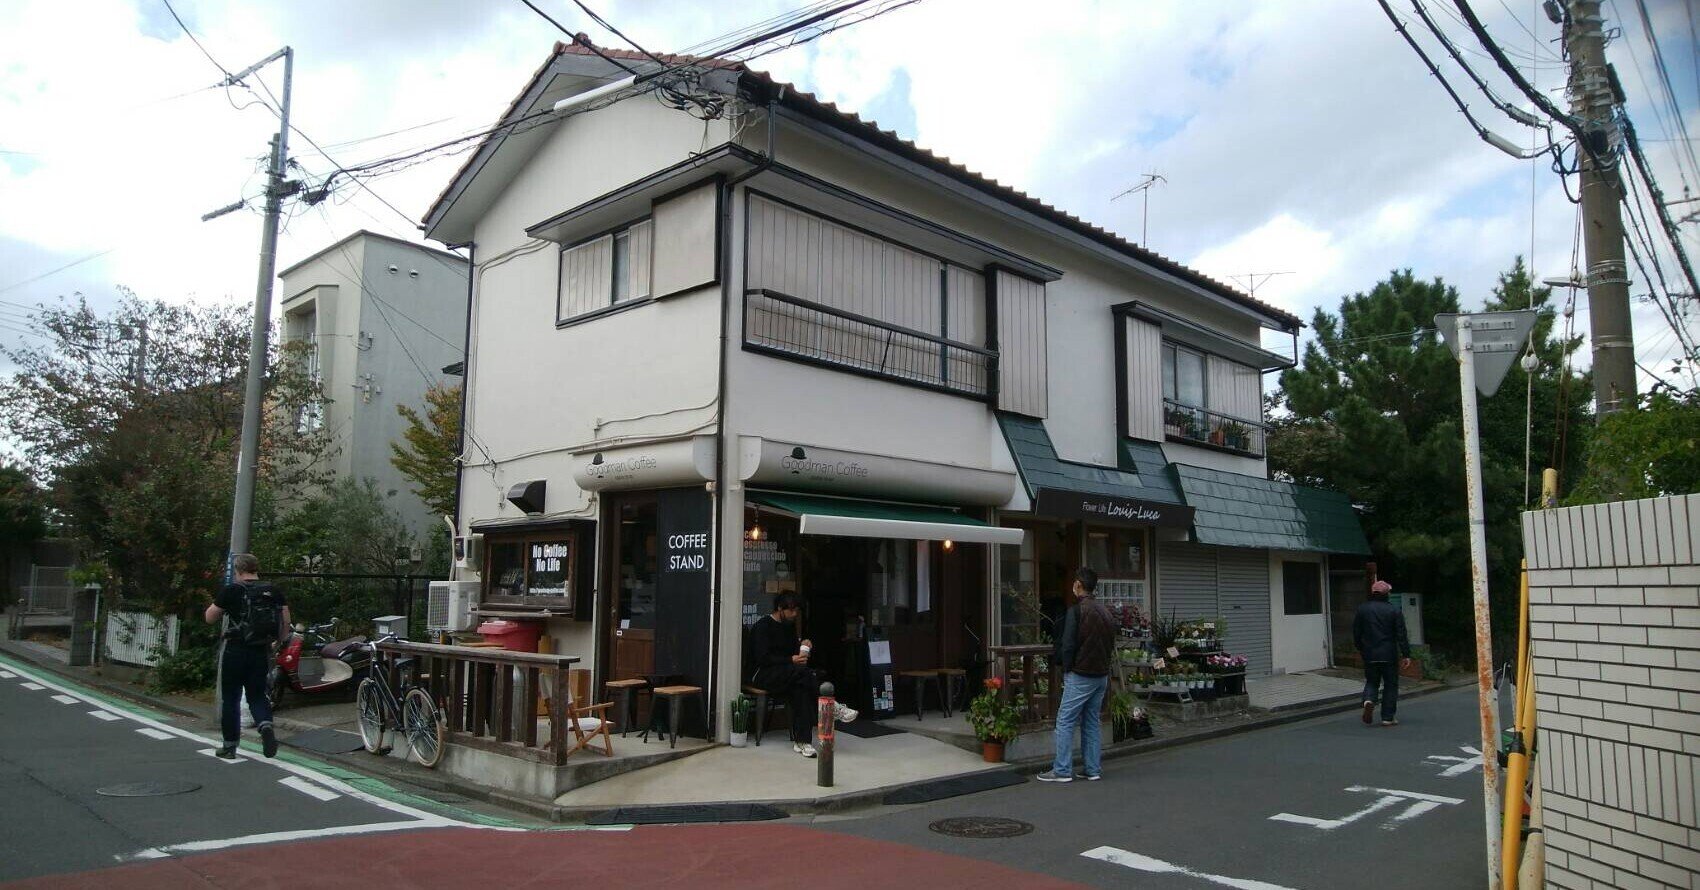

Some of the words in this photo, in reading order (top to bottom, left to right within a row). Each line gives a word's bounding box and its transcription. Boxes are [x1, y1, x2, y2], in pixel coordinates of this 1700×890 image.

[586, 461, 626, 476] Goodman
[628, 455, 656, 471] Coffee
[782, 456, 833, 474] Goodman
[836, 461, 868, 477] Coffee
[1107, 501, 1161, 519] Louis-Luca
[668, 533, 707, 549] COFFEE
[532, 544, 542, 558] No
[543, 543, 568, 558] Coffee
[536, 558, 546, 572] No
[547, 557, 561, 572] Life
[670, 554, 705, 570] STAND
[742, 603, 757, 614] and
